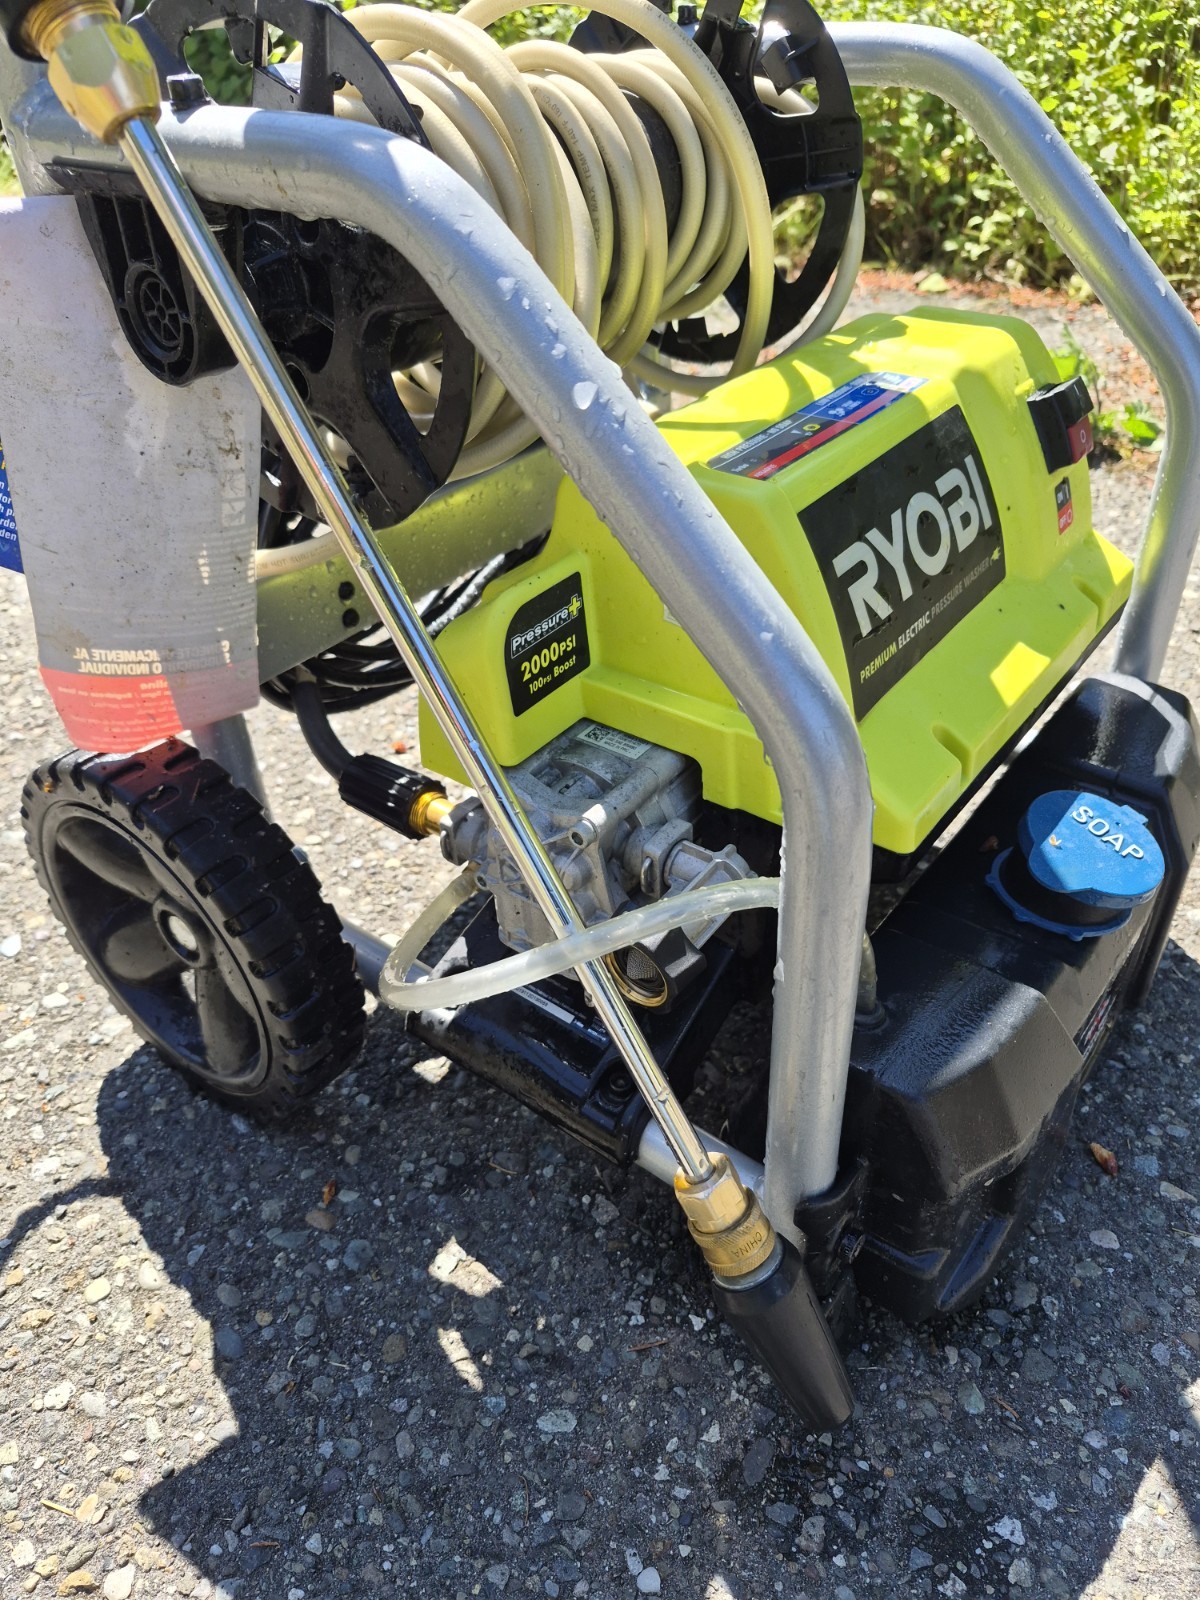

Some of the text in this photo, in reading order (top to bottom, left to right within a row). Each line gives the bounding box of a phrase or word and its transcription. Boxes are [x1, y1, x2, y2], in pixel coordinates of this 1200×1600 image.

[577, 151, 592, 180] TEMP
[832, 454, 993, 638] RYOBI
[859, 557, 991, 684] PREMIUM ELECTRIC PRESSURE WASHER
[520, 634, 577, 682] 2000PSI
[553, 655, 577, 678] Boost
[1071, 805, 1144, 859] SOAP
[731, 1231, 763, 1258] CHINA
